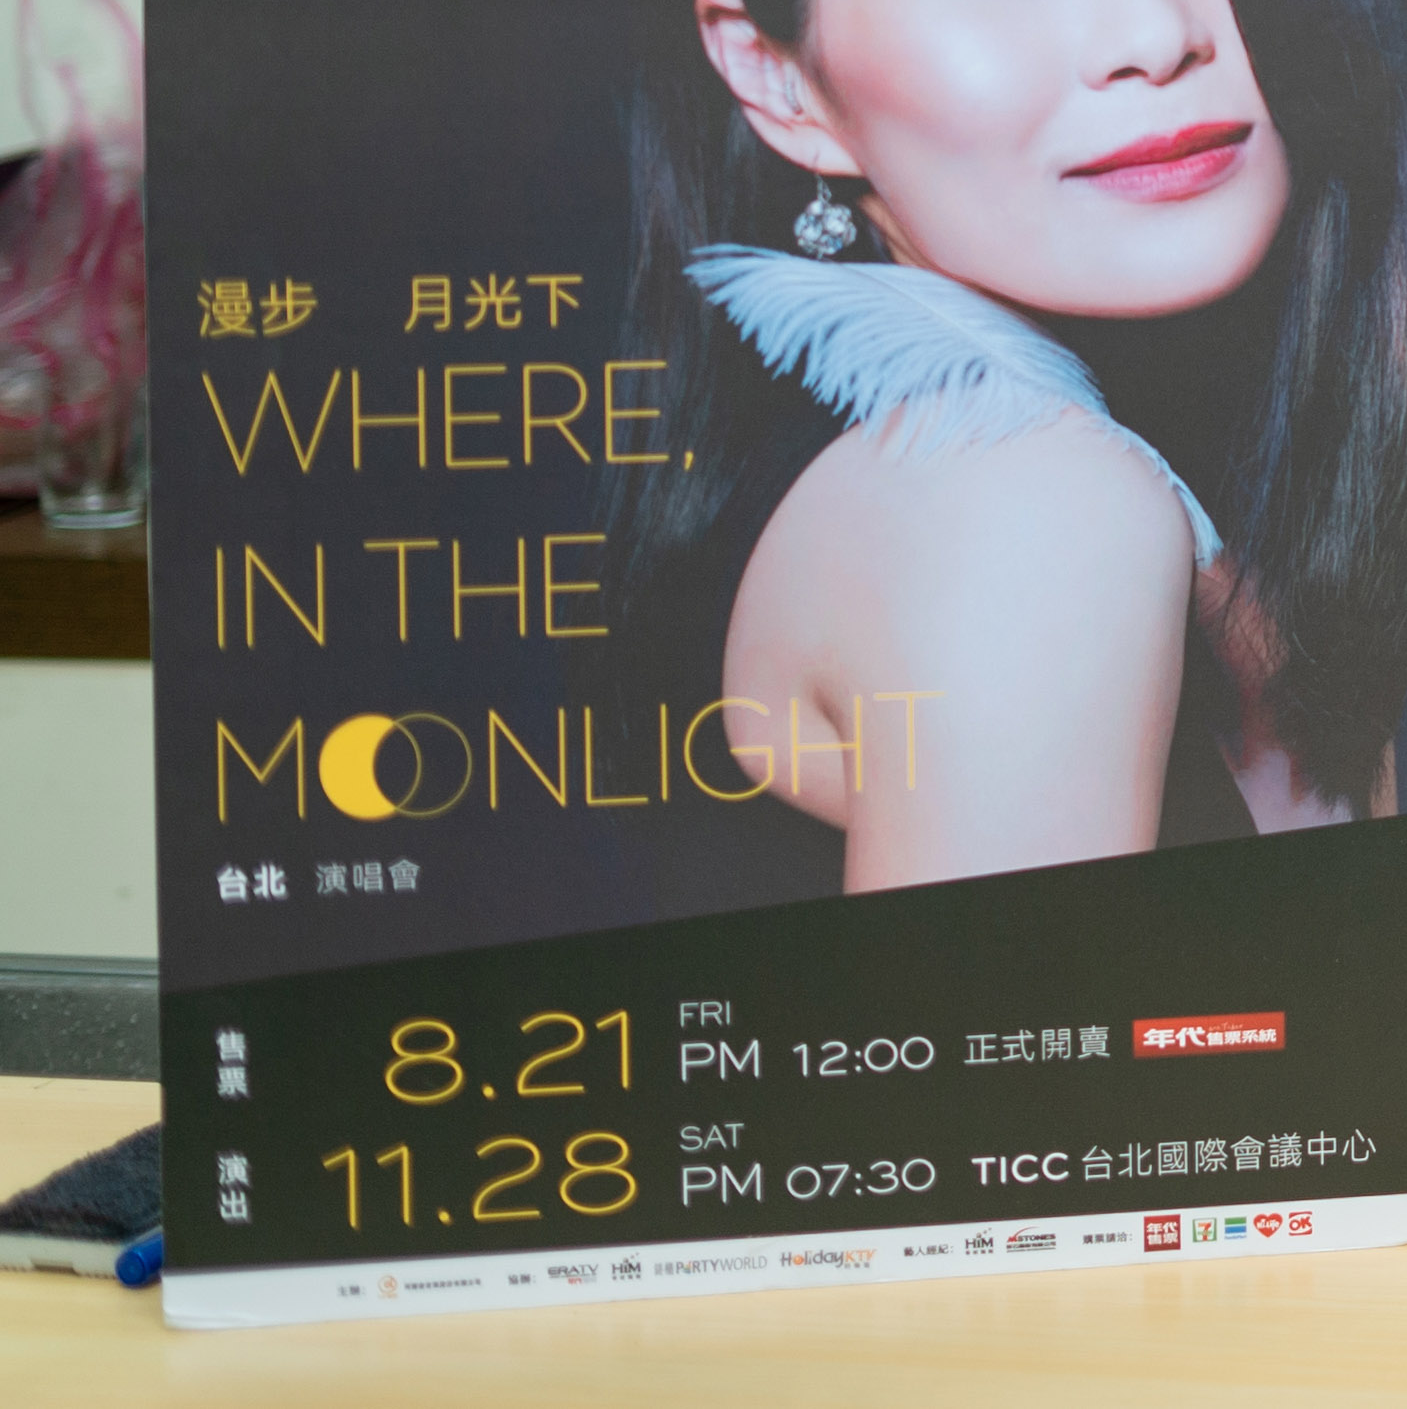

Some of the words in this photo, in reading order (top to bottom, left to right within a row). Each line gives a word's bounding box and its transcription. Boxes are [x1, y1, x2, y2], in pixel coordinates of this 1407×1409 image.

[198, 278, 318, 338] 漫步
[405, 274, 584, 333] 月光下
[202, 360, 696, 476] WHERE,
[216, 544, 326, 650] IN
[364, 534, 610, 643] THE
[217, 691, 946, 824] MOONLIGHT
[217, 865, 287, 900] 台北
[315, 860, 421, 894] 演唱會
[680, 1002, 732, 1027] FRI
[964, 1025, 1111, 1065] 正式開賣
[215, 1030, 250, 1100] 售票
[384, 1009, 634, 1106] 8.21
[681, 1040, 761, 1083] PM
[792, 1037, 936, 1078] 12:00
[681, 1123, 745, 1152] SAT
[972, 1152, 1070, 1186] TICC
[1081, 1128, 1378, 1182] 台北國際會議中心
[217, 1155, 250, 1222] 演出
[322, 1131, 637, 1231] 11.28
[682, 1163, 763, 1207] PM
[787, 1158, 937, 1201] 07:30
